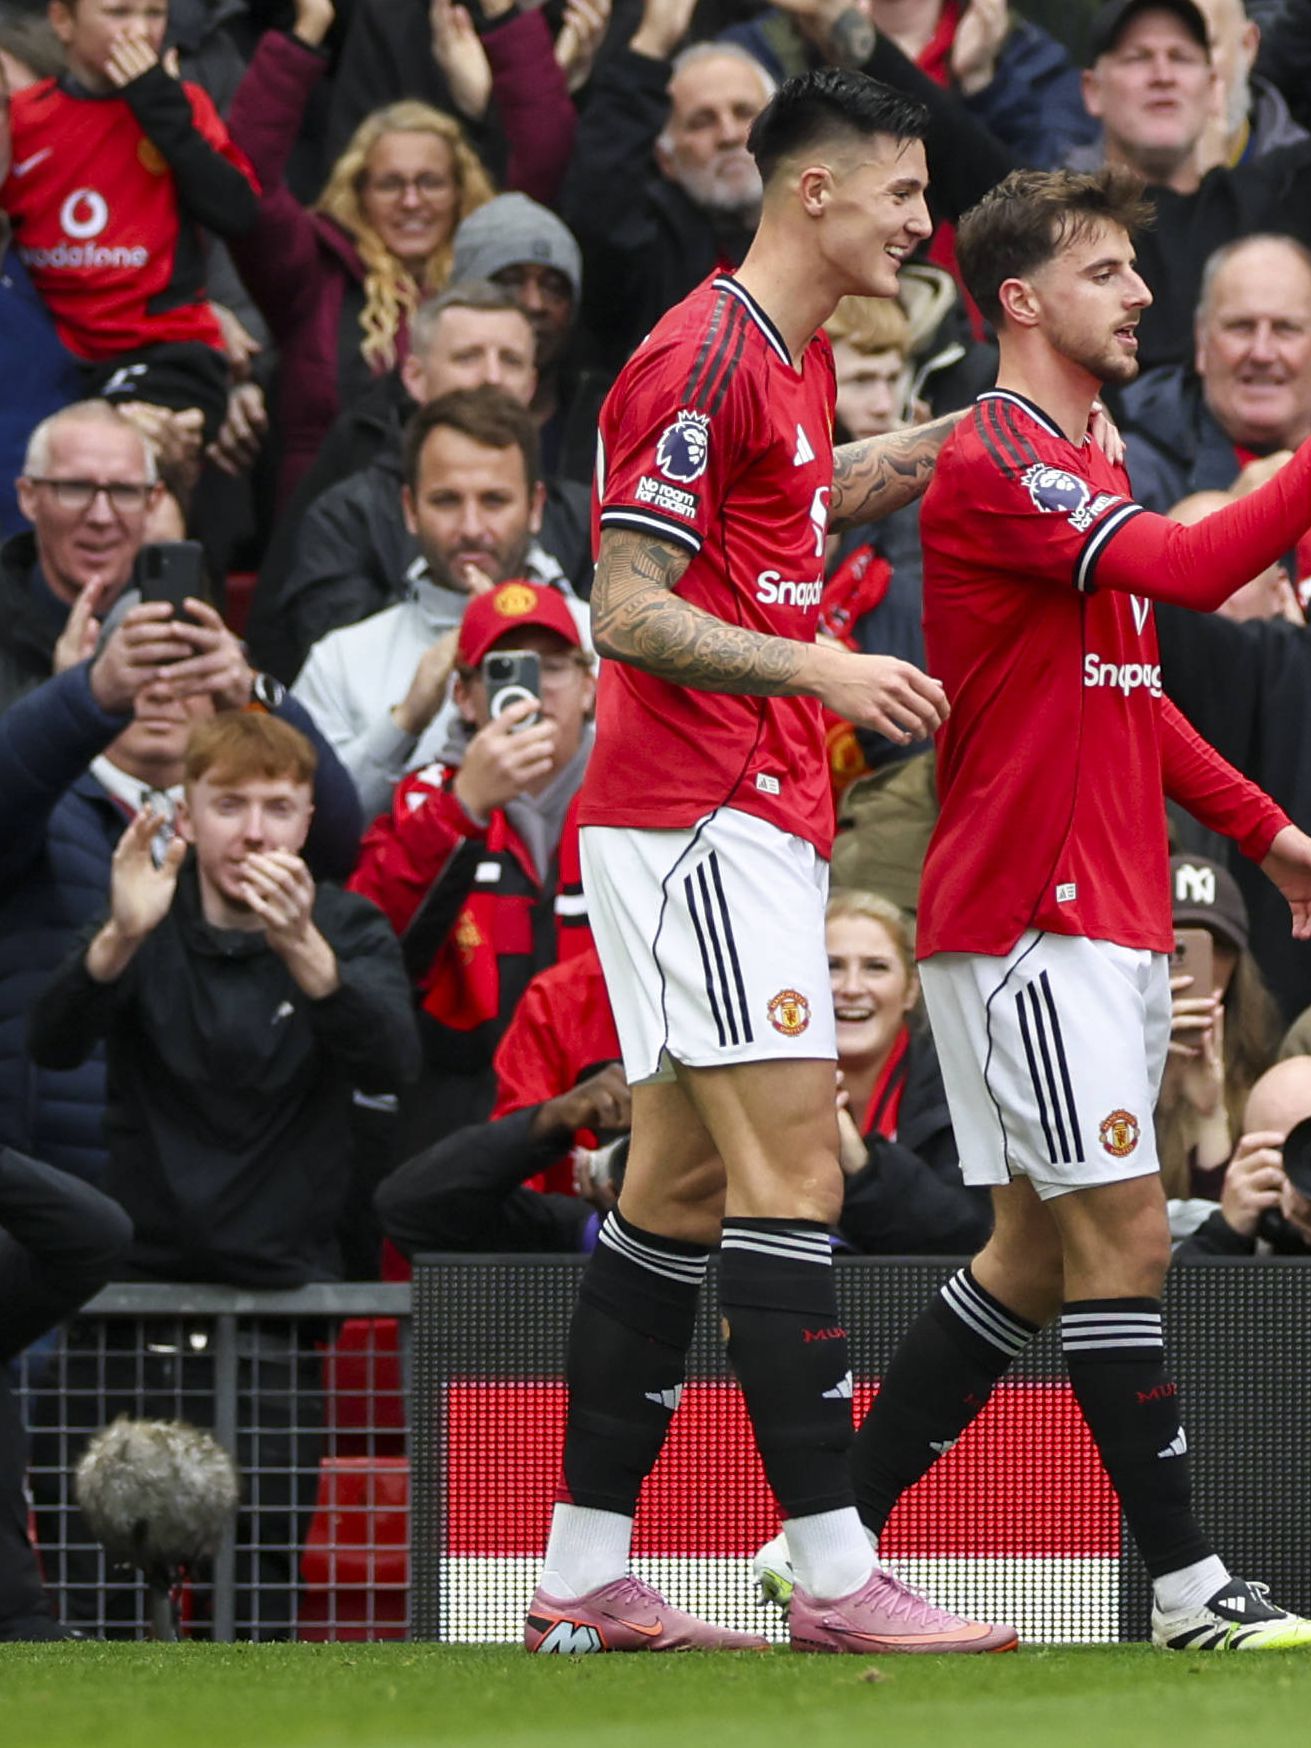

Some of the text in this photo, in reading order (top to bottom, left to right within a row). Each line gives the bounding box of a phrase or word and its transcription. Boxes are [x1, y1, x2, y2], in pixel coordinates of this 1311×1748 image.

[634, 487, 696, 519] for racism
[637, 475, 695, 506] No room
